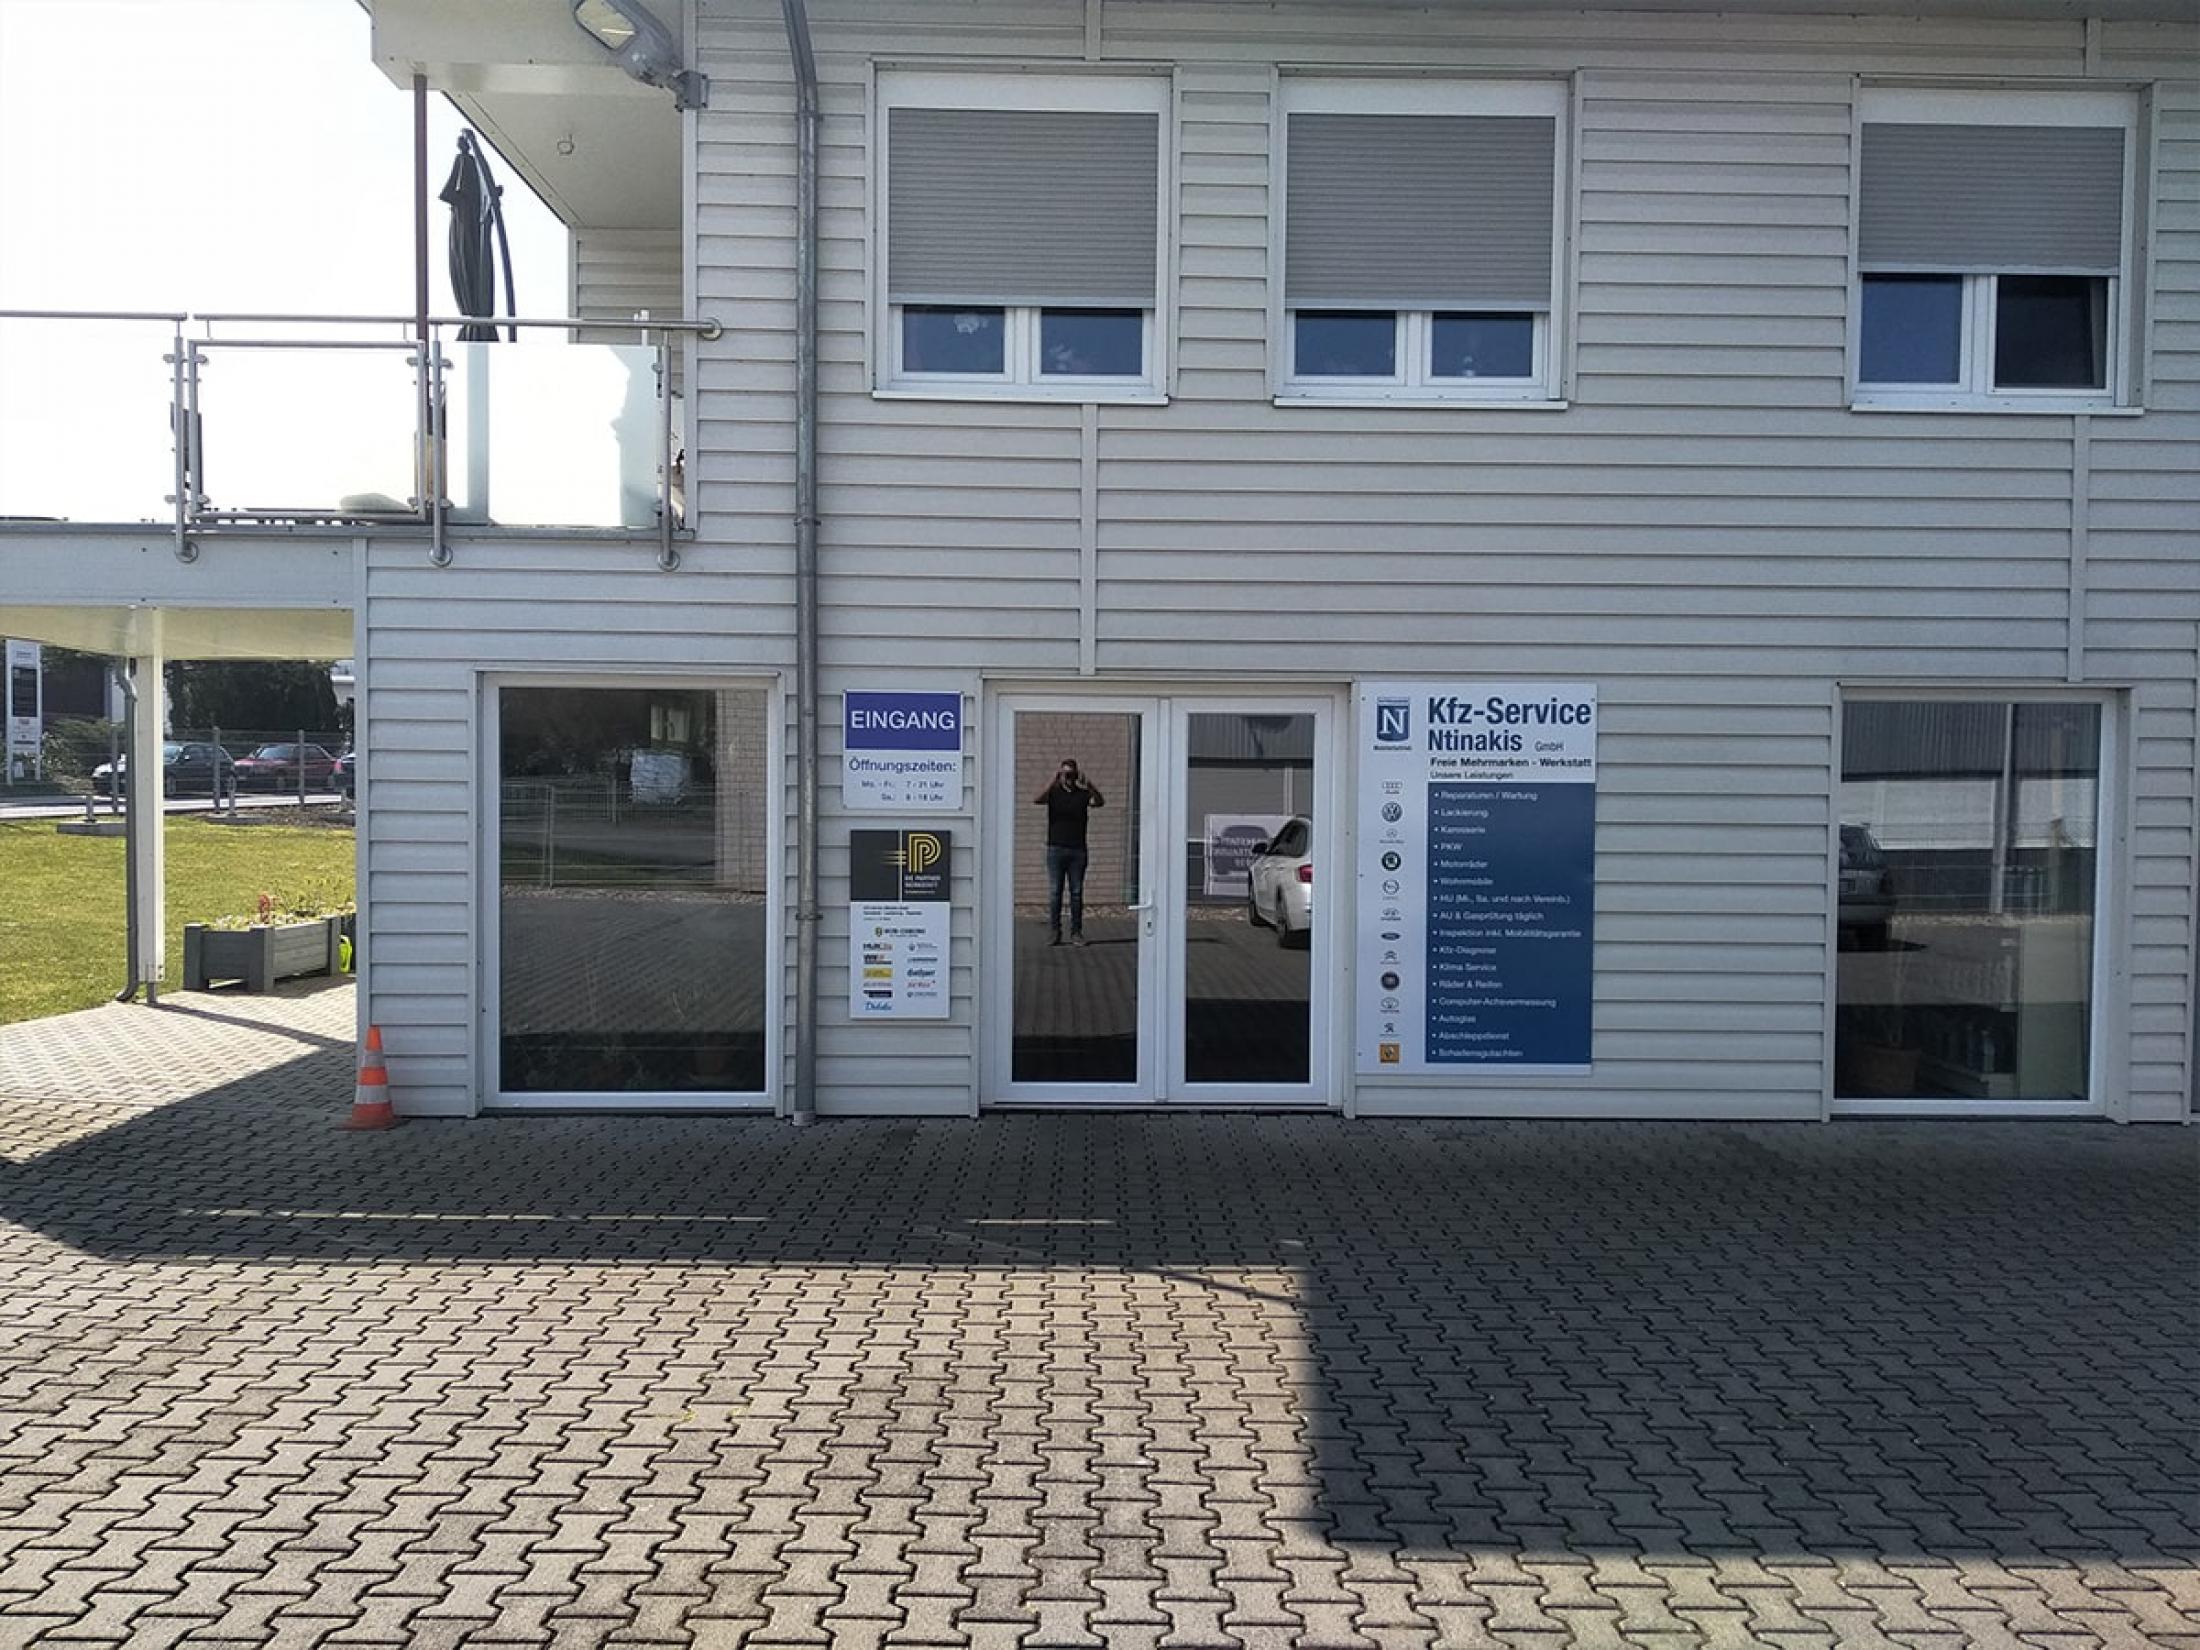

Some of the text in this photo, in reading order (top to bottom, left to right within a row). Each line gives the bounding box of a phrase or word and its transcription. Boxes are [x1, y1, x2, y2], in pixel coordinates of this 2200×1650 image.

[851, 710, 956, 730] EINGANG
[1428, 697, 1592, 725] Kfz-Service
[1428, 729, 1564, 751] Ntinakis GmbH
[849, 757, 957, 775] Öffnungszeiten:
[1430, 757, 1458, 767] Freie
[1461, 757, 1530, 767] Mehrmarken
[1539, 757, 1592, 767] Werkstatt
[1430, 771, 1461, 779] Unsere
[1464, 963, 1497, 971] Service
